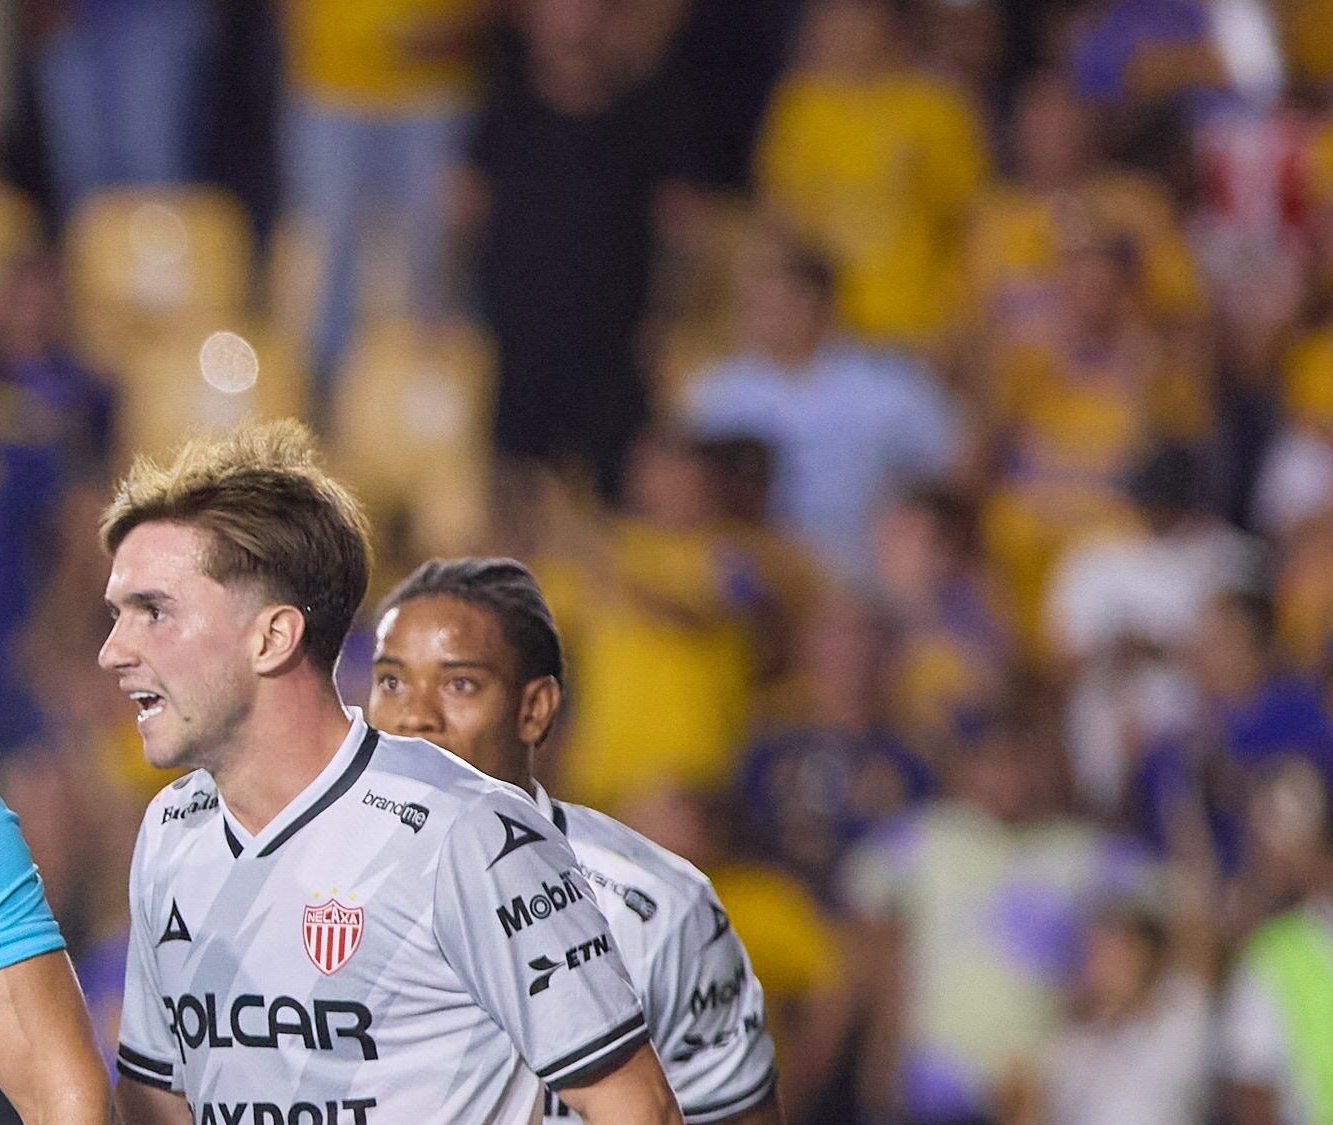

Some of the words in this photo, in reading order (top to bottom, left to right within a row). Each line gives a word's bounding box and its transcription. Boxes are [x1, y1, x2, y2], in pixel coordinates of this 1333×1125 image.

[362, 789, 430, 834] brandme
[306, 911, 359, 926] NECAXA
[565, 933, 610, 971] ETN
